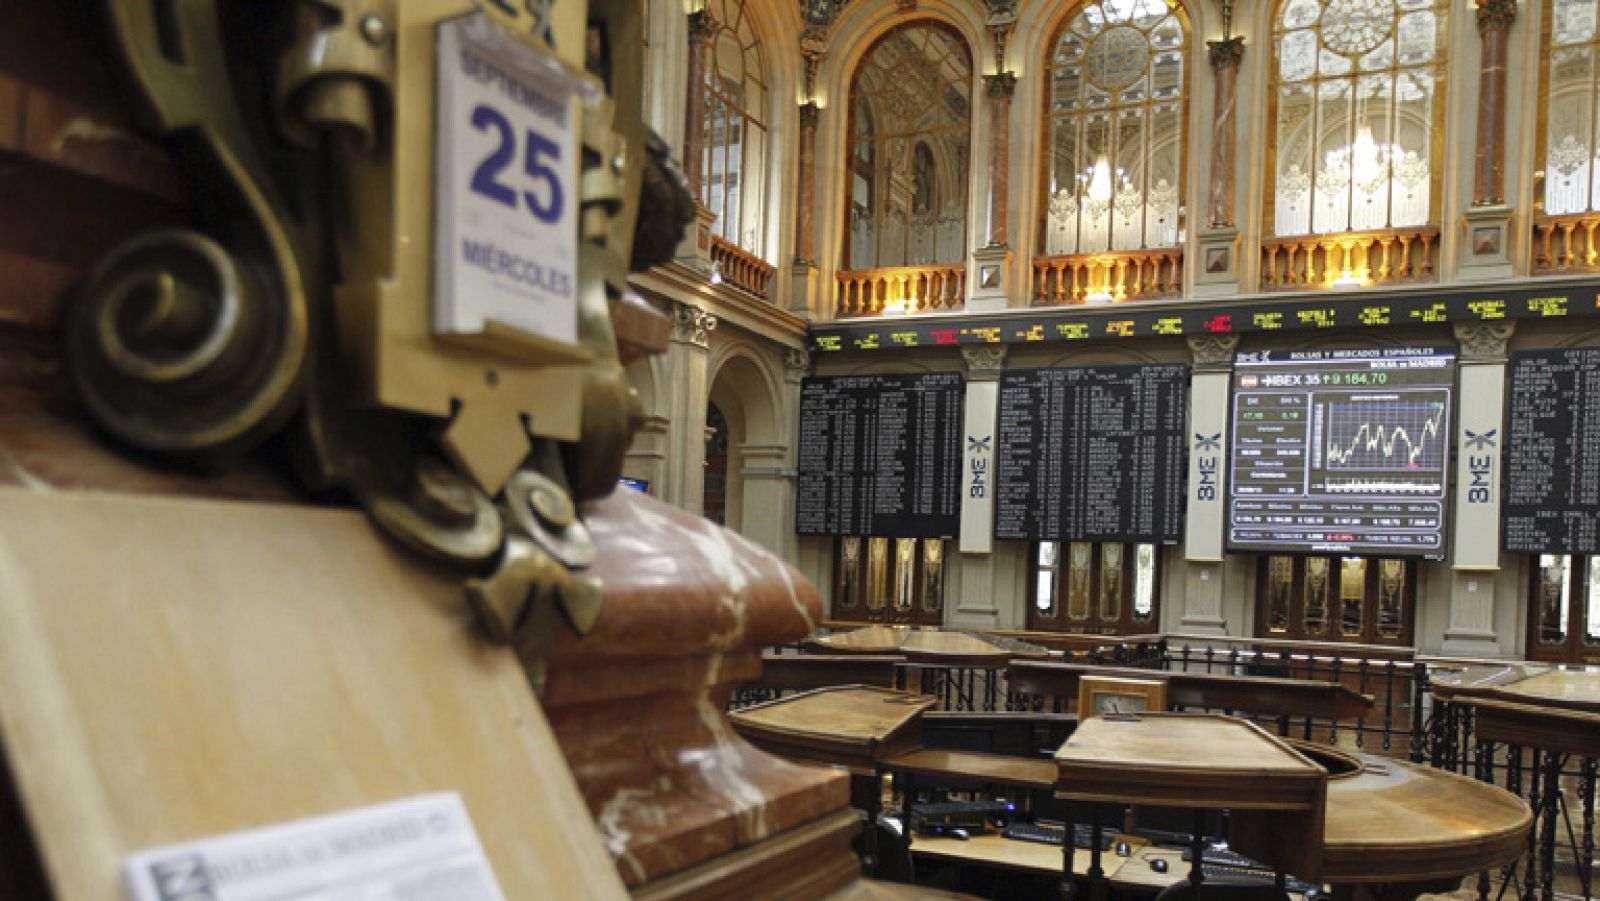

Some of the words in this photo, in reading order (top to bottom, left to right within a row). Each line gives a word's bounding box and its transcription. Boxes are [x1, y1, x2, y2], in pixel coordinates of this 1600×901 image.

[469, 103, 565, 226] 25
[462, 238, 572, 298] MIÉRCOLES
[1198, 456, 1216, 501] BME
[1468, 454, 1491, 504] BME
